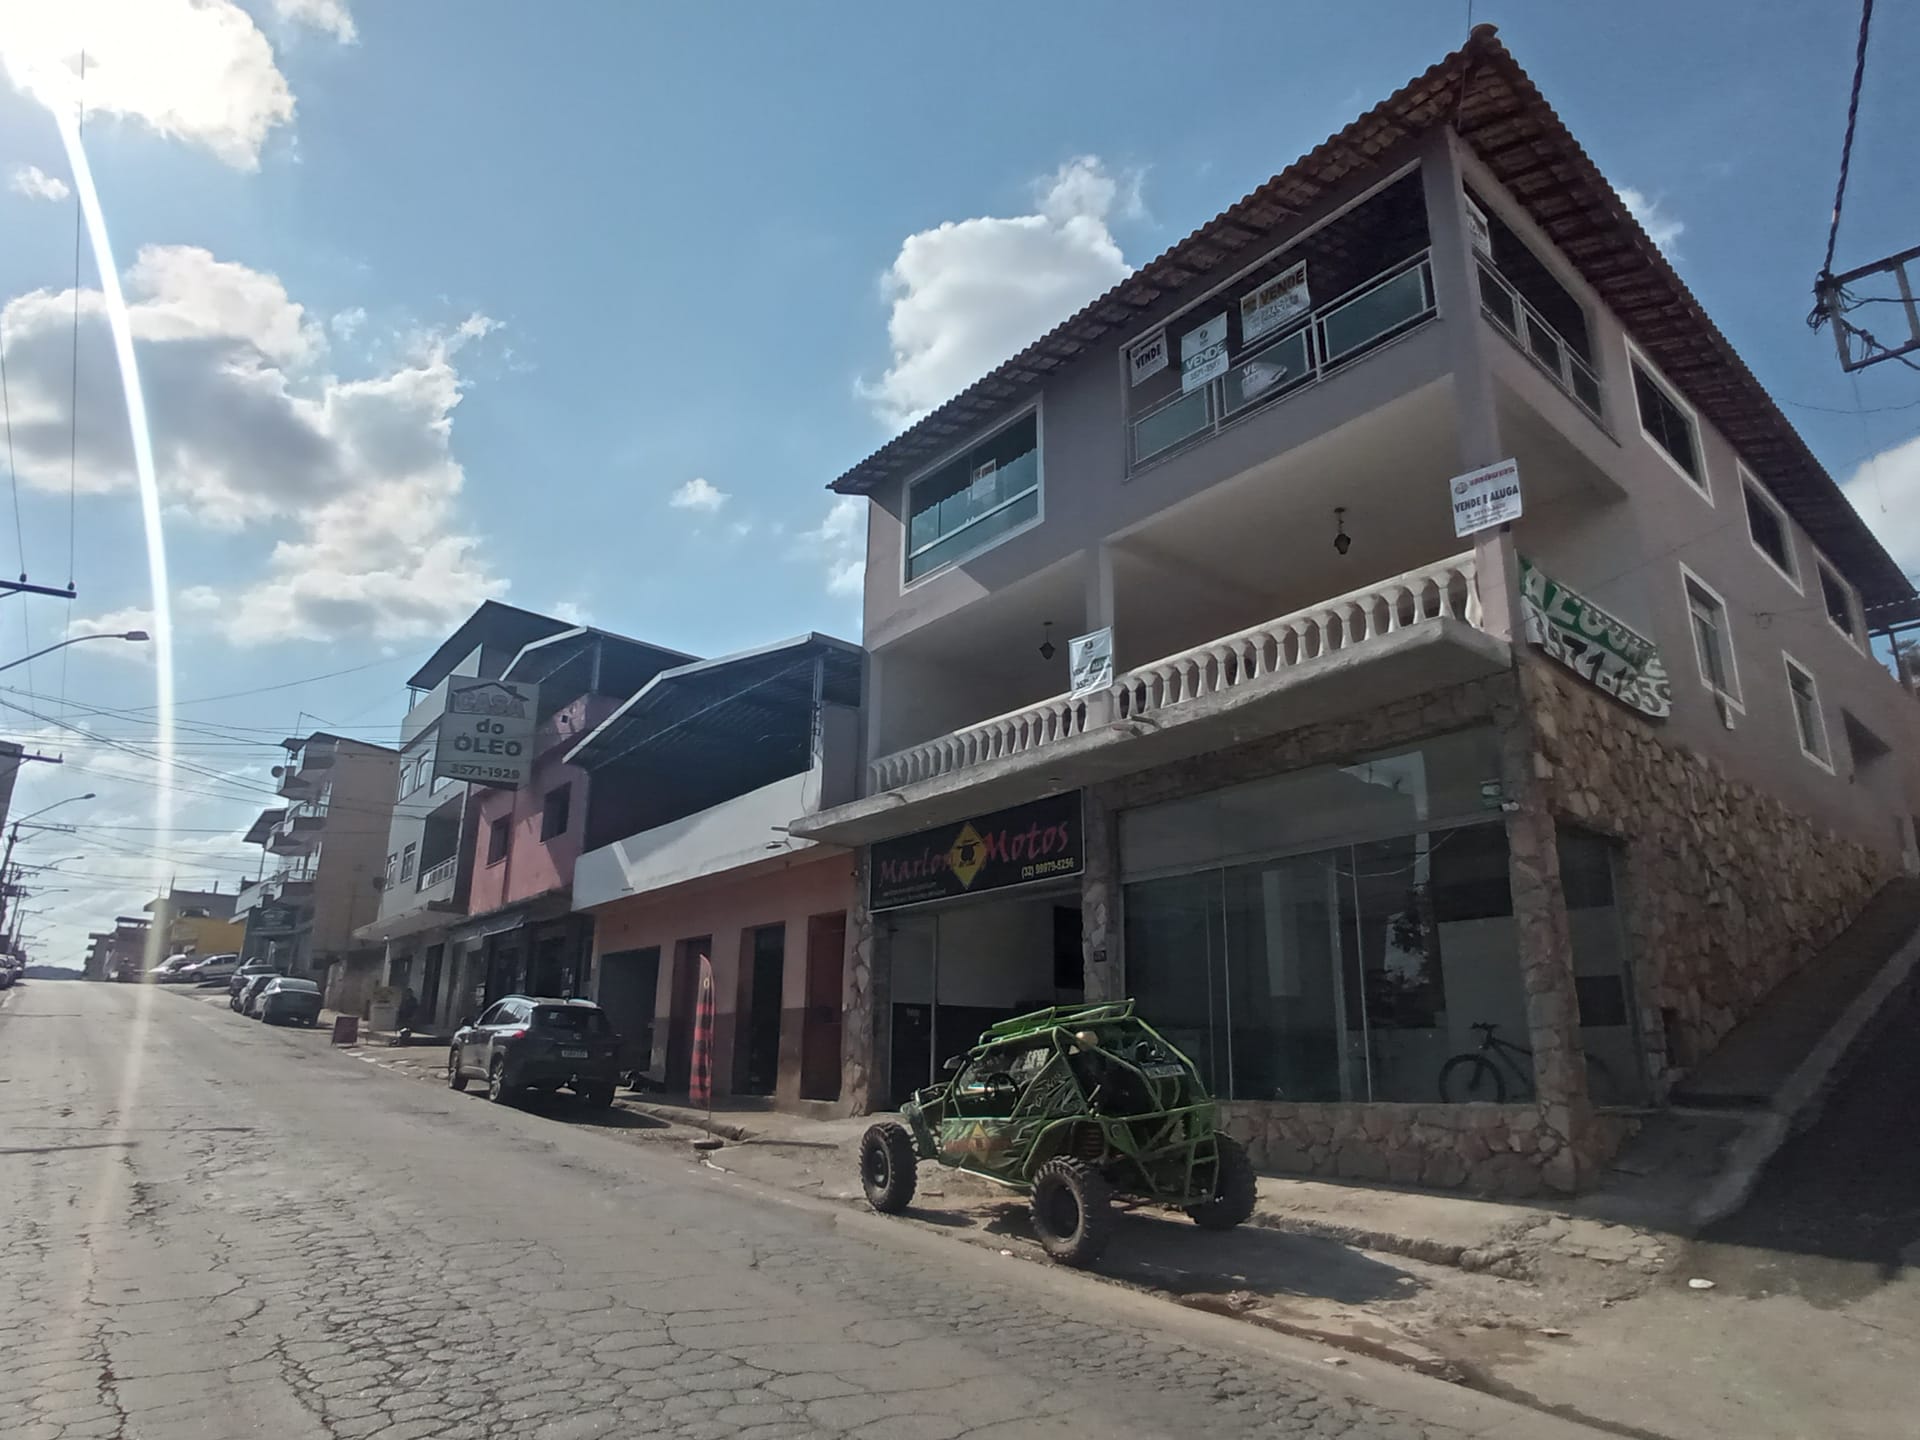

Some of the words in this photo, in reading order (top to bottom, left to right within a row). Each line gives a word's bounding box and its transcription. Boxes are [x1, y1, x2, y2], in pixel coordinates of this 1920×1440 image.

[1259, 266, 1305, 305] VENDE
[1136, 343, 1161, 369] VENDE
[1185, 341, 1225, 370] VENDE
[1454, 496, 1481, 513] VENDE
[1490, 485, 1519, 502] ALUGA
[476, 719, 504, 735] do
[454, 732, 522, 757] ÓLEO
[982, 821, 1069, 863] Motos
